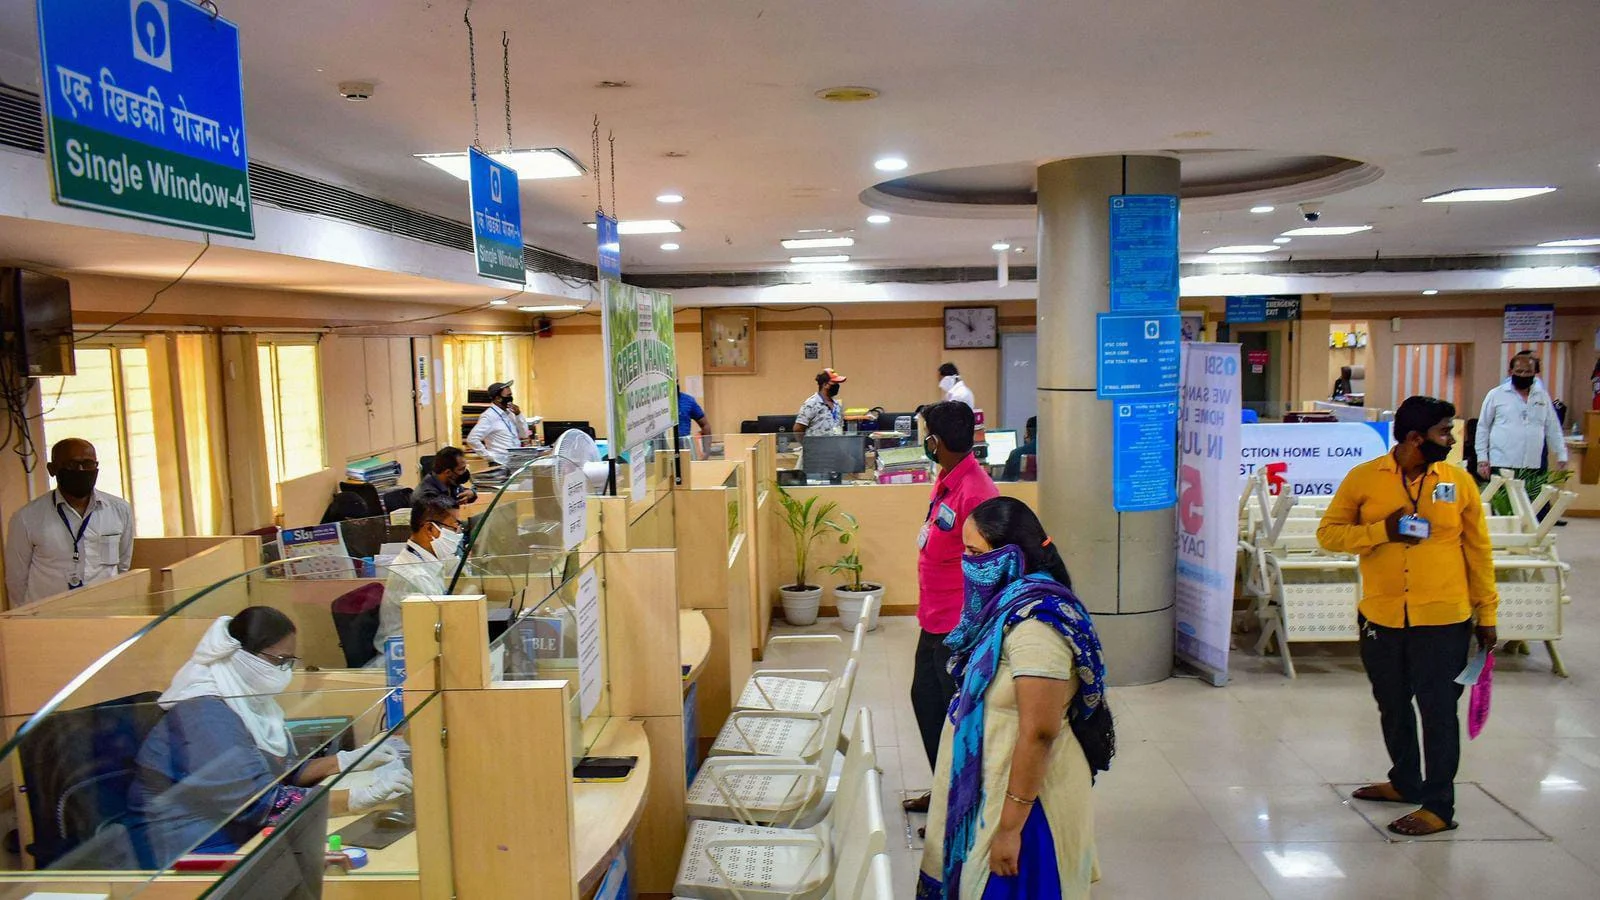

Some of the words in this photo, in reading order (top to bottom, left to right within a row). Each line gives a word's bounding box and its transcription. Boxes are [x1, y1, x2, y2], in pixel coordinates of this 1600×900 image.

[57, 64, 93, 118] एक
[98, 67, 165, 135] खिडकी
[66, 138, 143, 194] Single
[147, 159, 246, 212] Window-4
[479, 243, 497, 268] Single
[1266, 300, 1299, 308] EMERGENCY
[1266, 308, 1278, 316] EXIT
[616, 338, 643, 395] GREEN
[1241, 447, 1279, 458] CTION
[1283, 447, 1320, 458] HOME
[1327, 447, 1362, 457] LOAN
[1266, 460, 1288, 496] 5
[1294, 483, 1333, 495] DAYS
